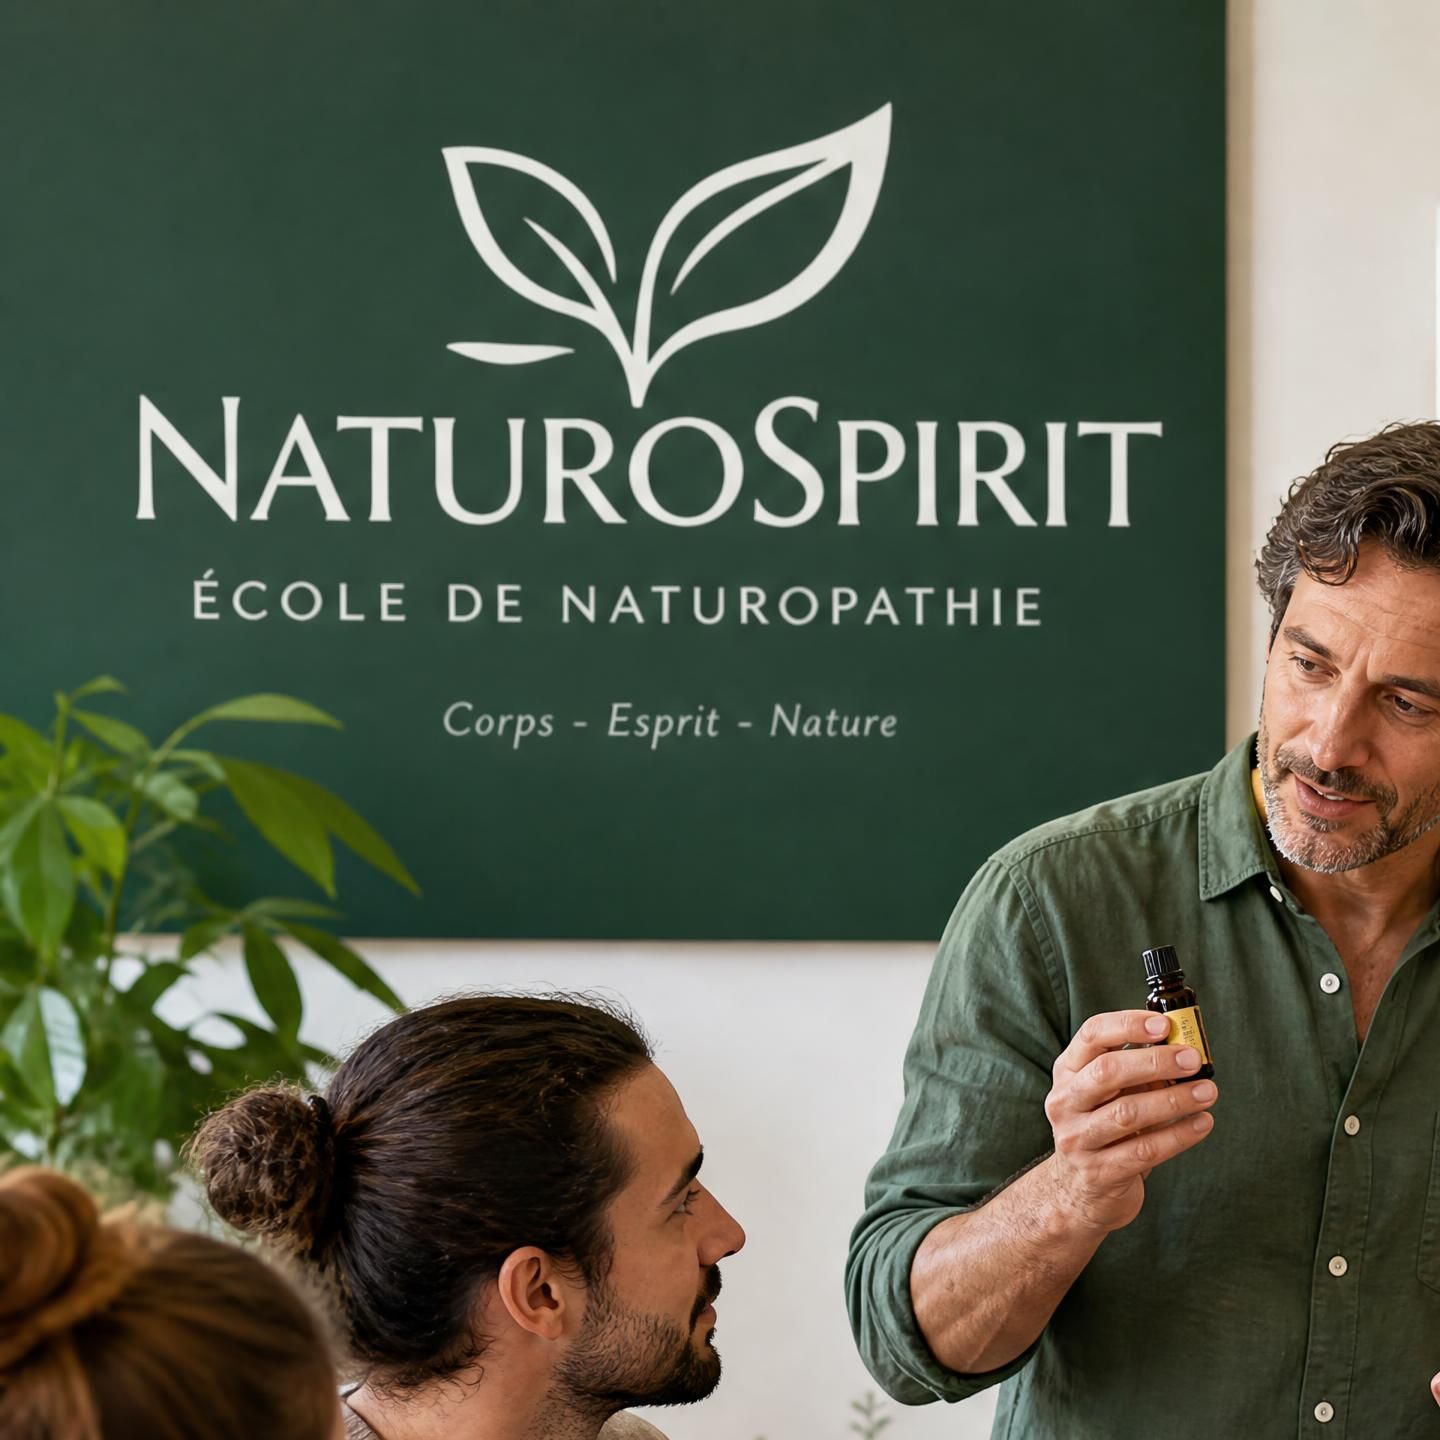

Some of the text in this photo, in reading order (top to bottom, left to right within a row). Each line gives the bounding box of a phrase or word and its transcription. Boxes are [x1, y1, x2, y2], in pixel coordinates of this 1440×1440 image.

[192, 567, 1042, 627] ÉCOLE DE NATUROPATHIE
[442, 700, 554, 750] Corps
[607, 702, 720, 751] Esprit
[769, 703, 898, 738] Nature
